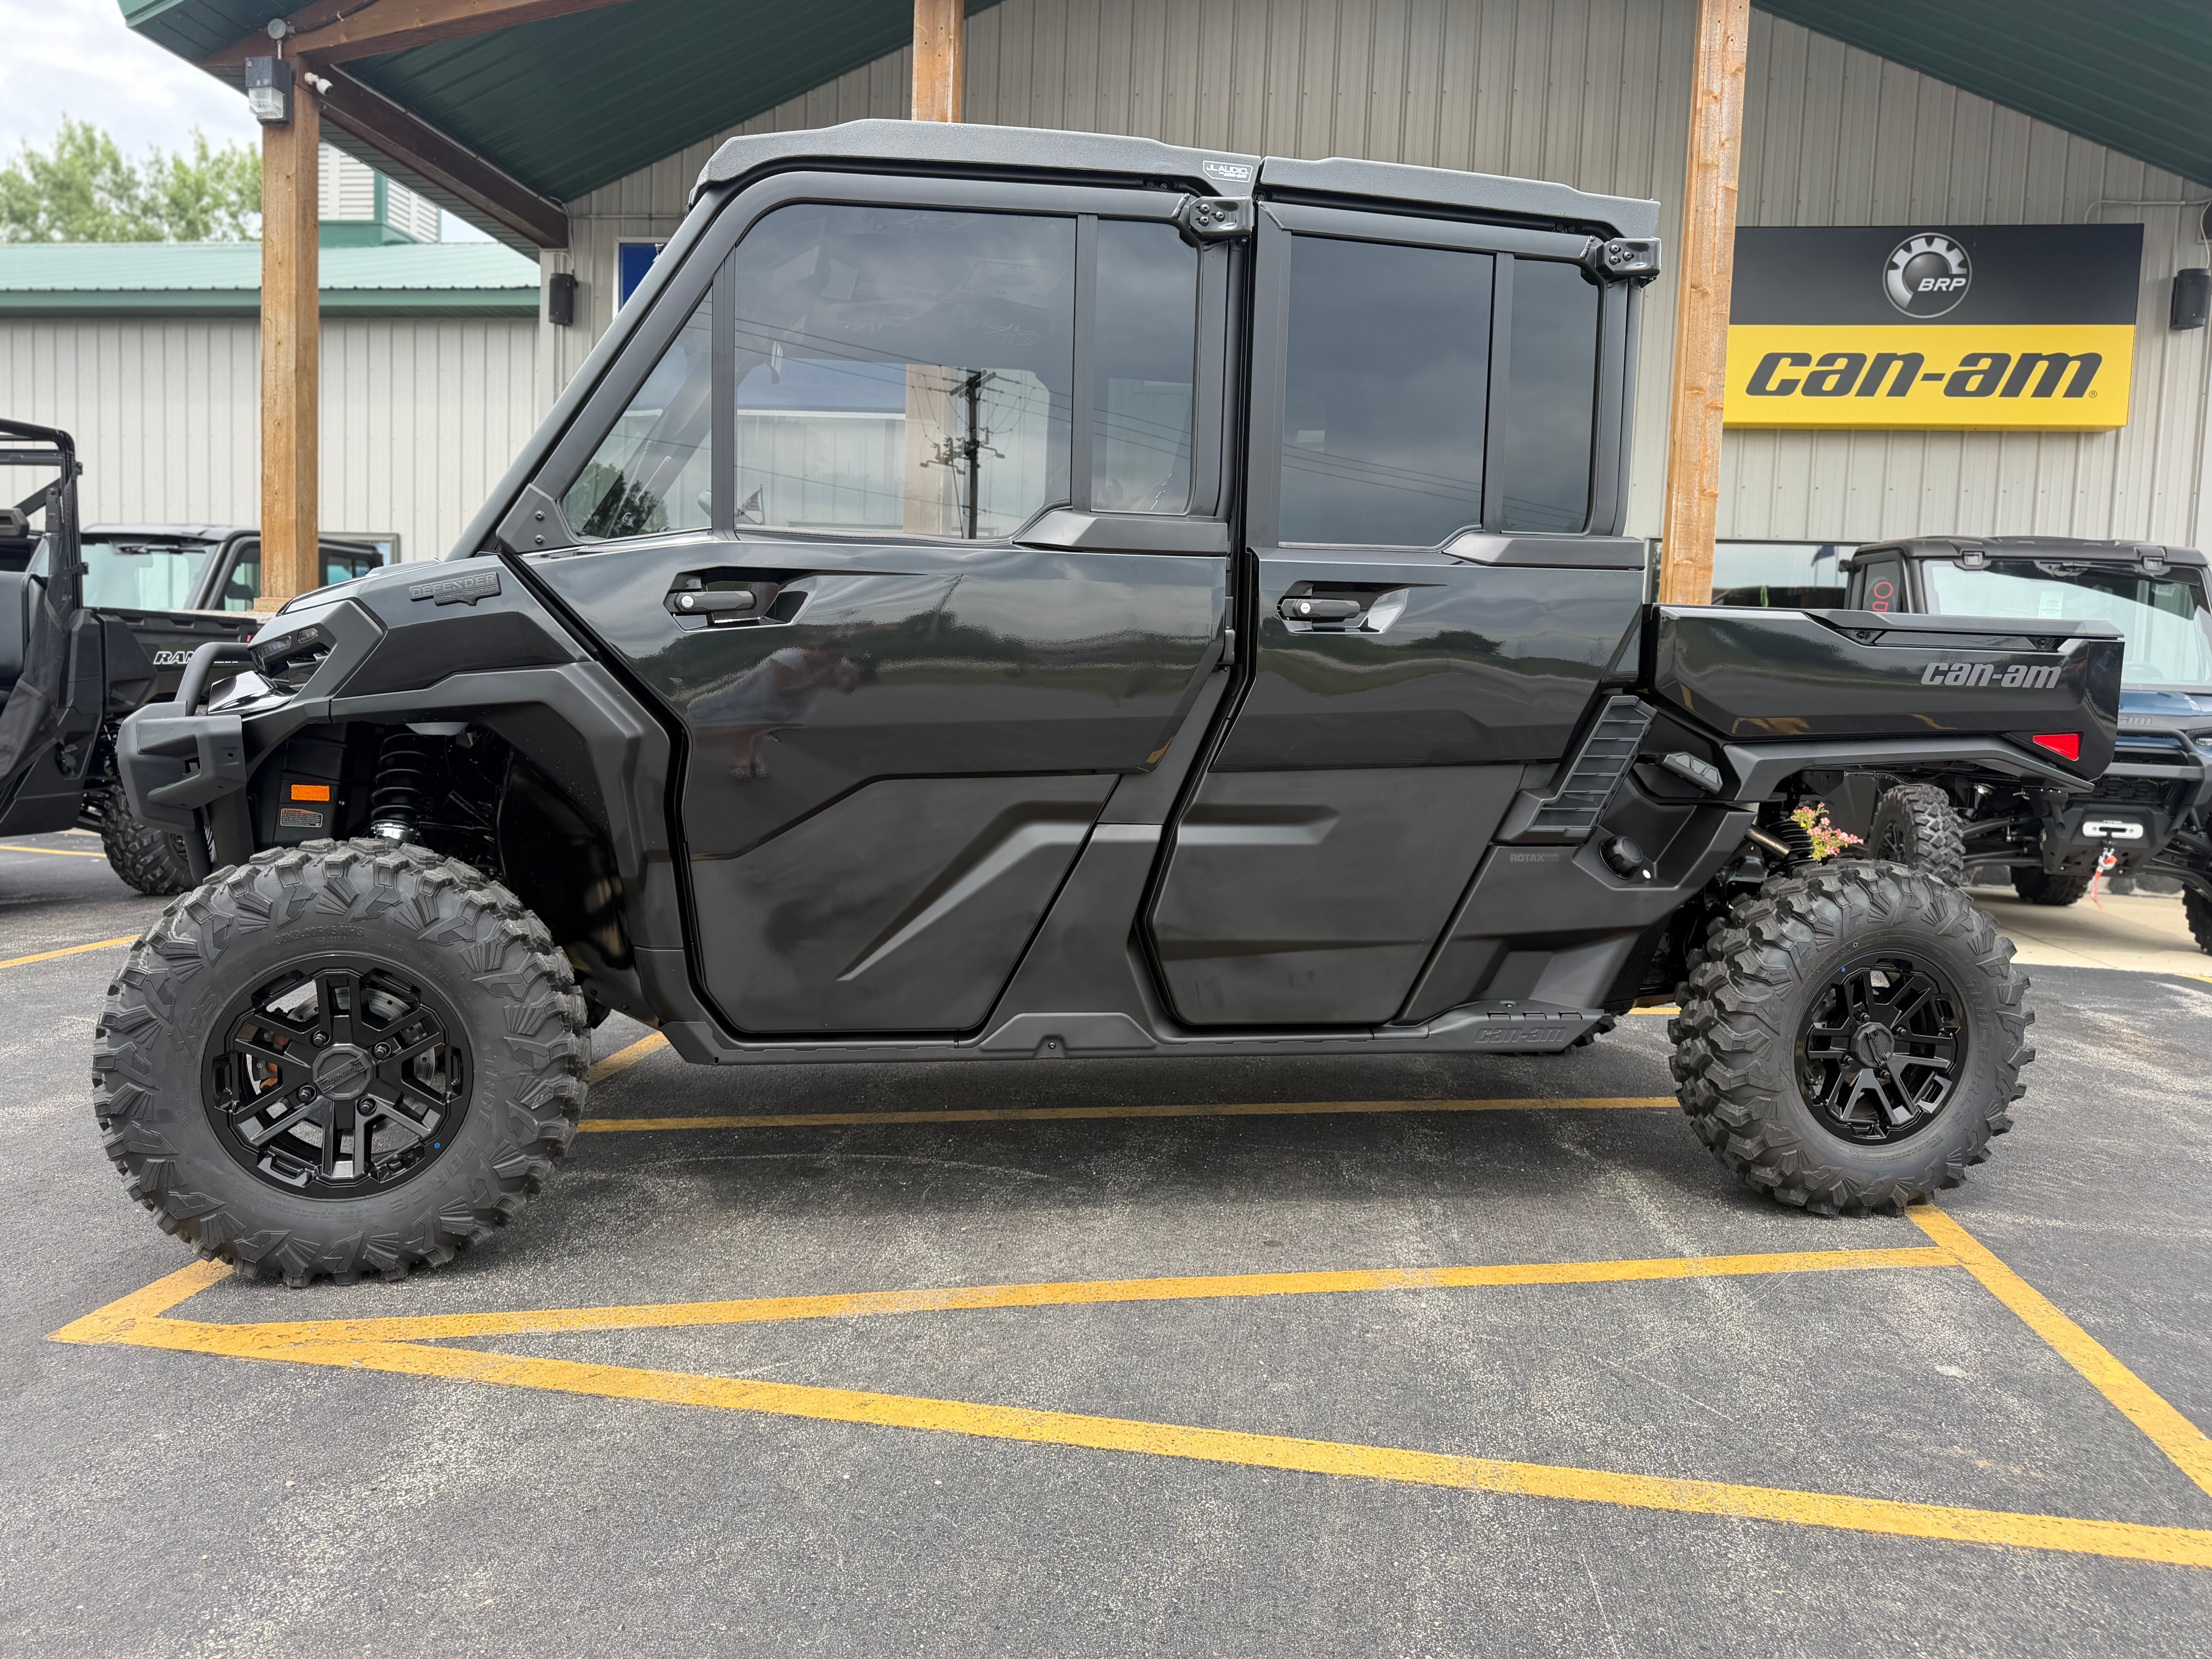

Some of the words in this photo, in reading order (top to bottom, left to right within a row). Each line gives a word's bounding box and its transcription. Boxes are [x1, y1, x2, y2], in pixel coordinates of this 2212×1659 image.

[1917, 278, 1966, 291] BRP
[1745, 352, 2103, 398] can-am
[411, 574, 496, 597] DEFENDER
[1921, 662, 2062, 689] can-am
[1475, 1028, 1567, 1043] can-am
[1952, 1046, 1990, 1125] FORCE
[390, 1138, 476, 1214] FORCE
